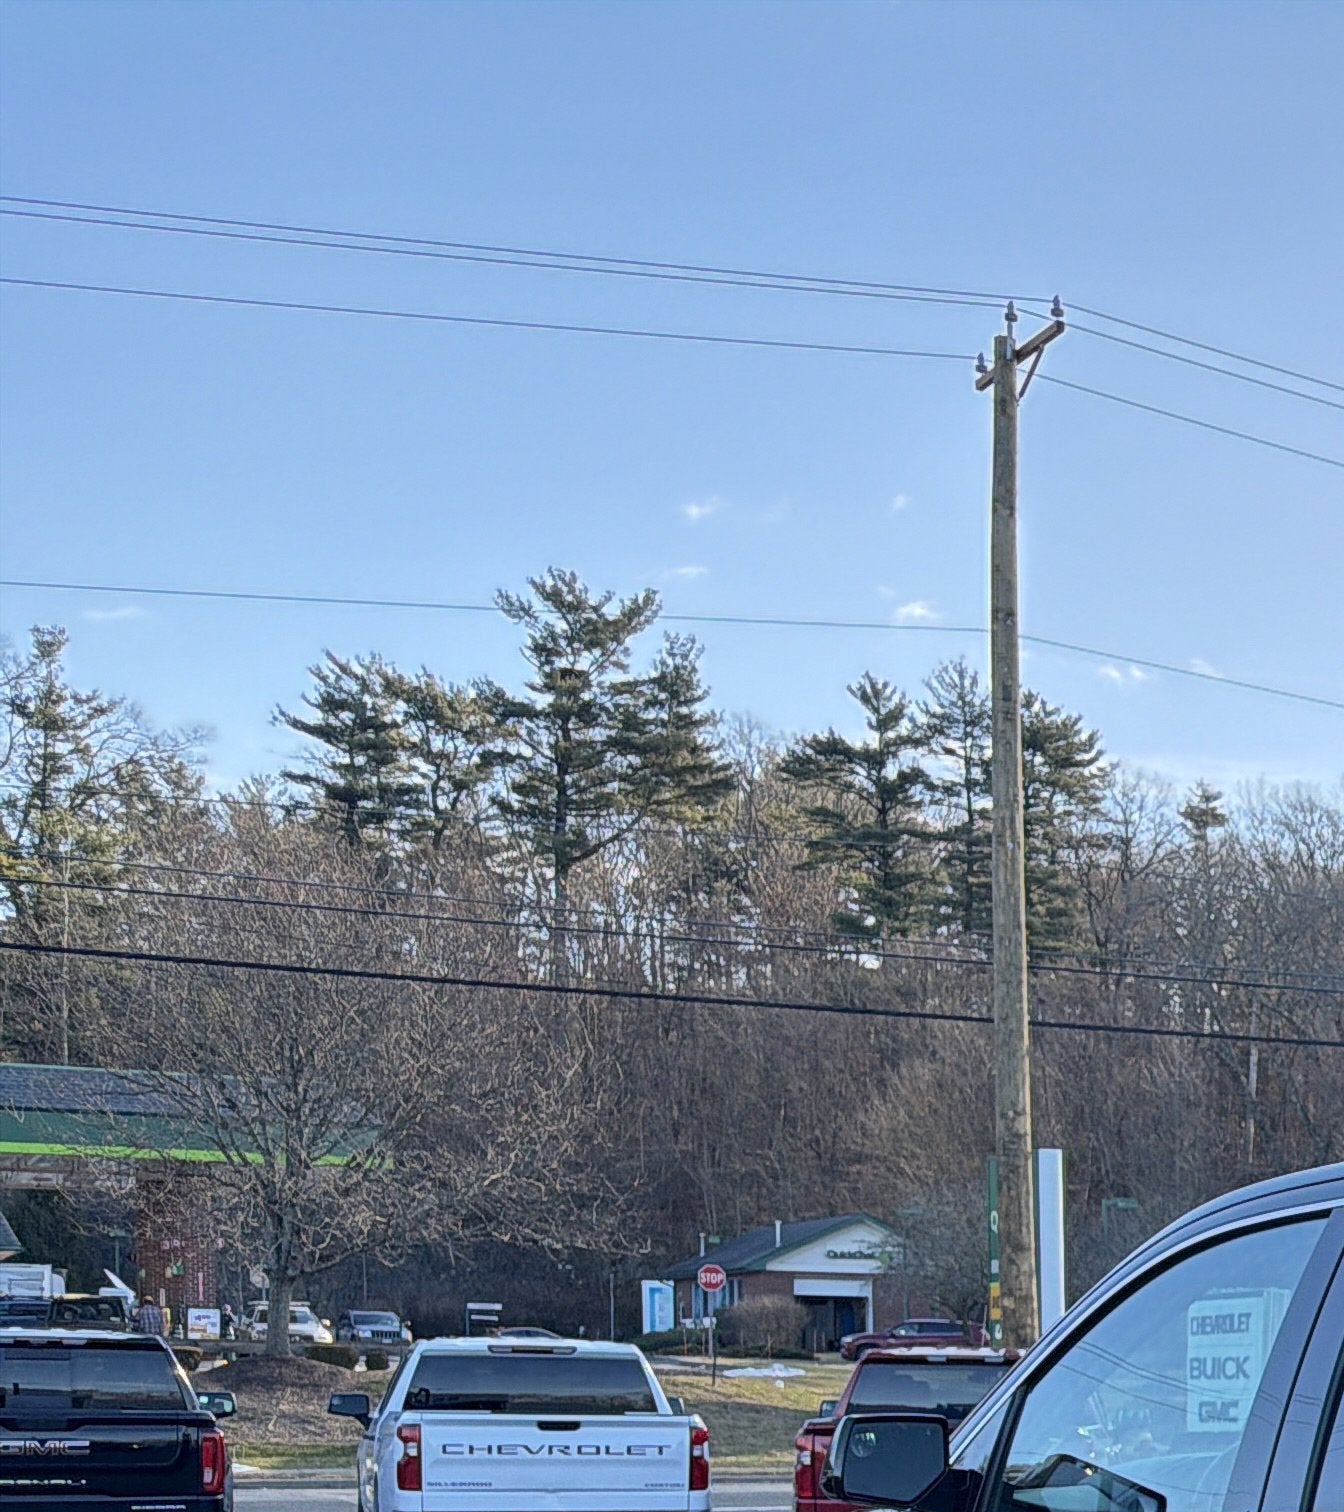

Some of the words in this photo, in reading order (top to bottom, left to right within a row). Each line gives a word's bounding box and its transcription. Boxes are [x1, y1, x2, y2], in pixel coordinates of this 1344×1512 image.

[700, 1272, 724, 1284] STOP
[1190, 1355, 1250, 1380] BUICK
[1199, 1400, 1239, 1423] GMC
[0, 1440, 90, 1456] GMC
[441, 1443, 672, 1456] CHEVROLET
